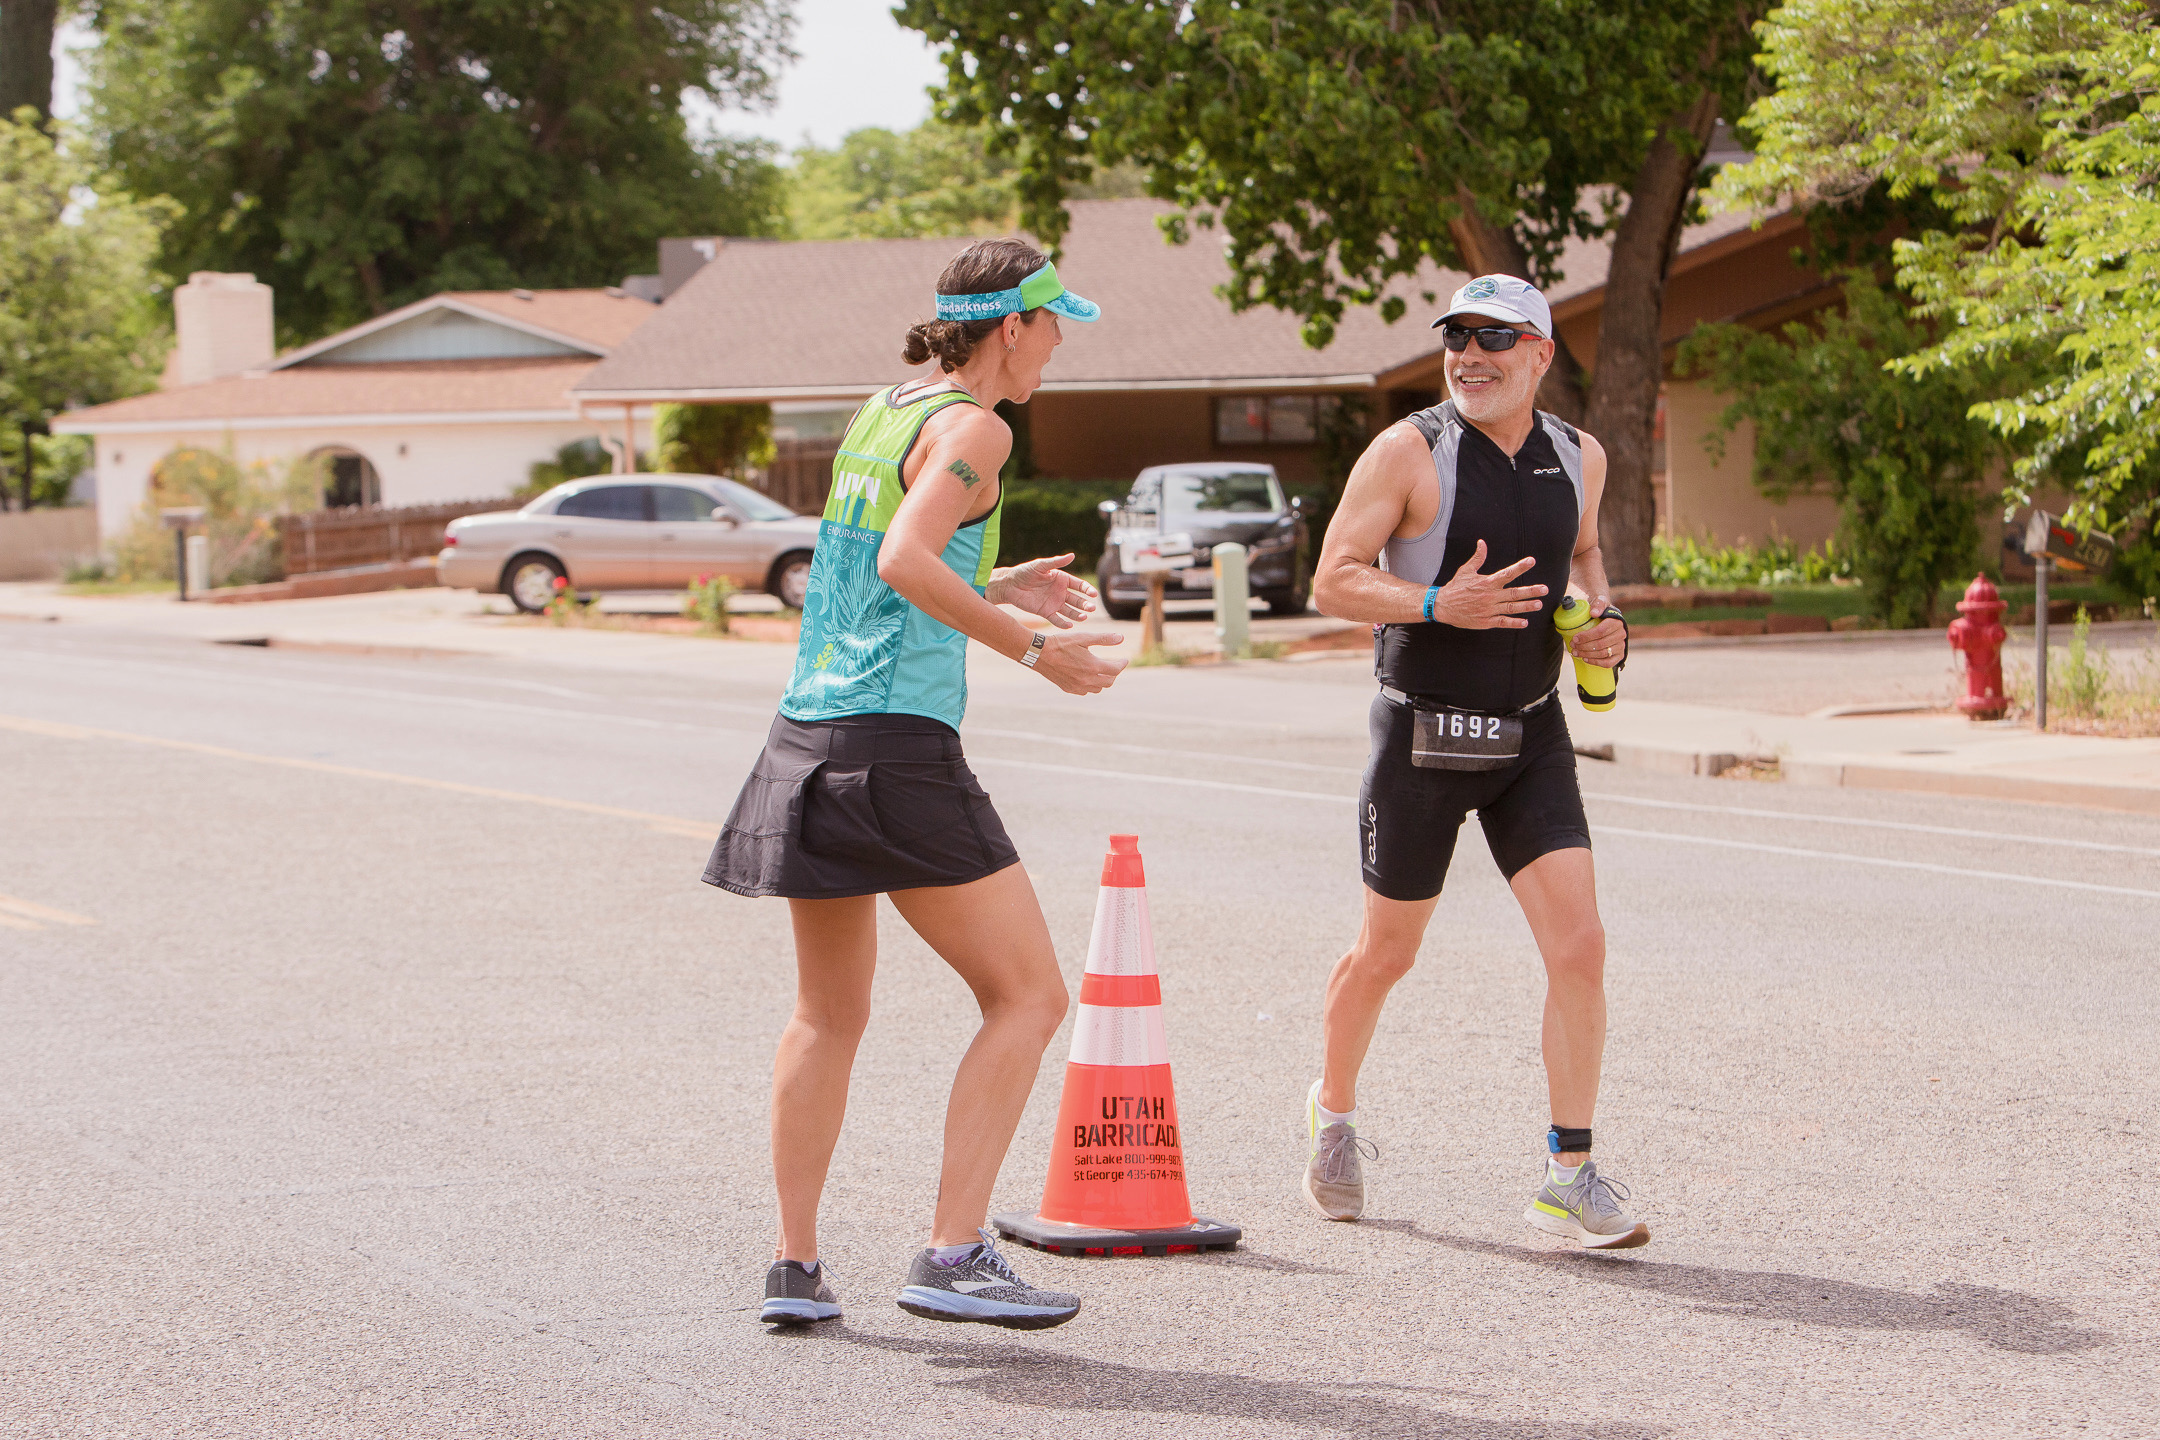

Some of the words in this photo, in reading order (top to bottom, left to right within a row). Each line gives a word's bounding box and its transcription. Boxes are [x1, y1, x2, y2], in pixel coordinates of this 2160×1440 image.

[827, 525, 876, 545] ENDURANCE
[1436, 713, 1500, 739] 1692
[1102, 1096, 1165, 1120] UTAH
[1075, 1154, 1093, 1165] Salt
[1096, 1154, 1122, 1164] Lake
[1074, 1170, 1084, 1181] St
[1087, 1170, 1124, 1182] George
